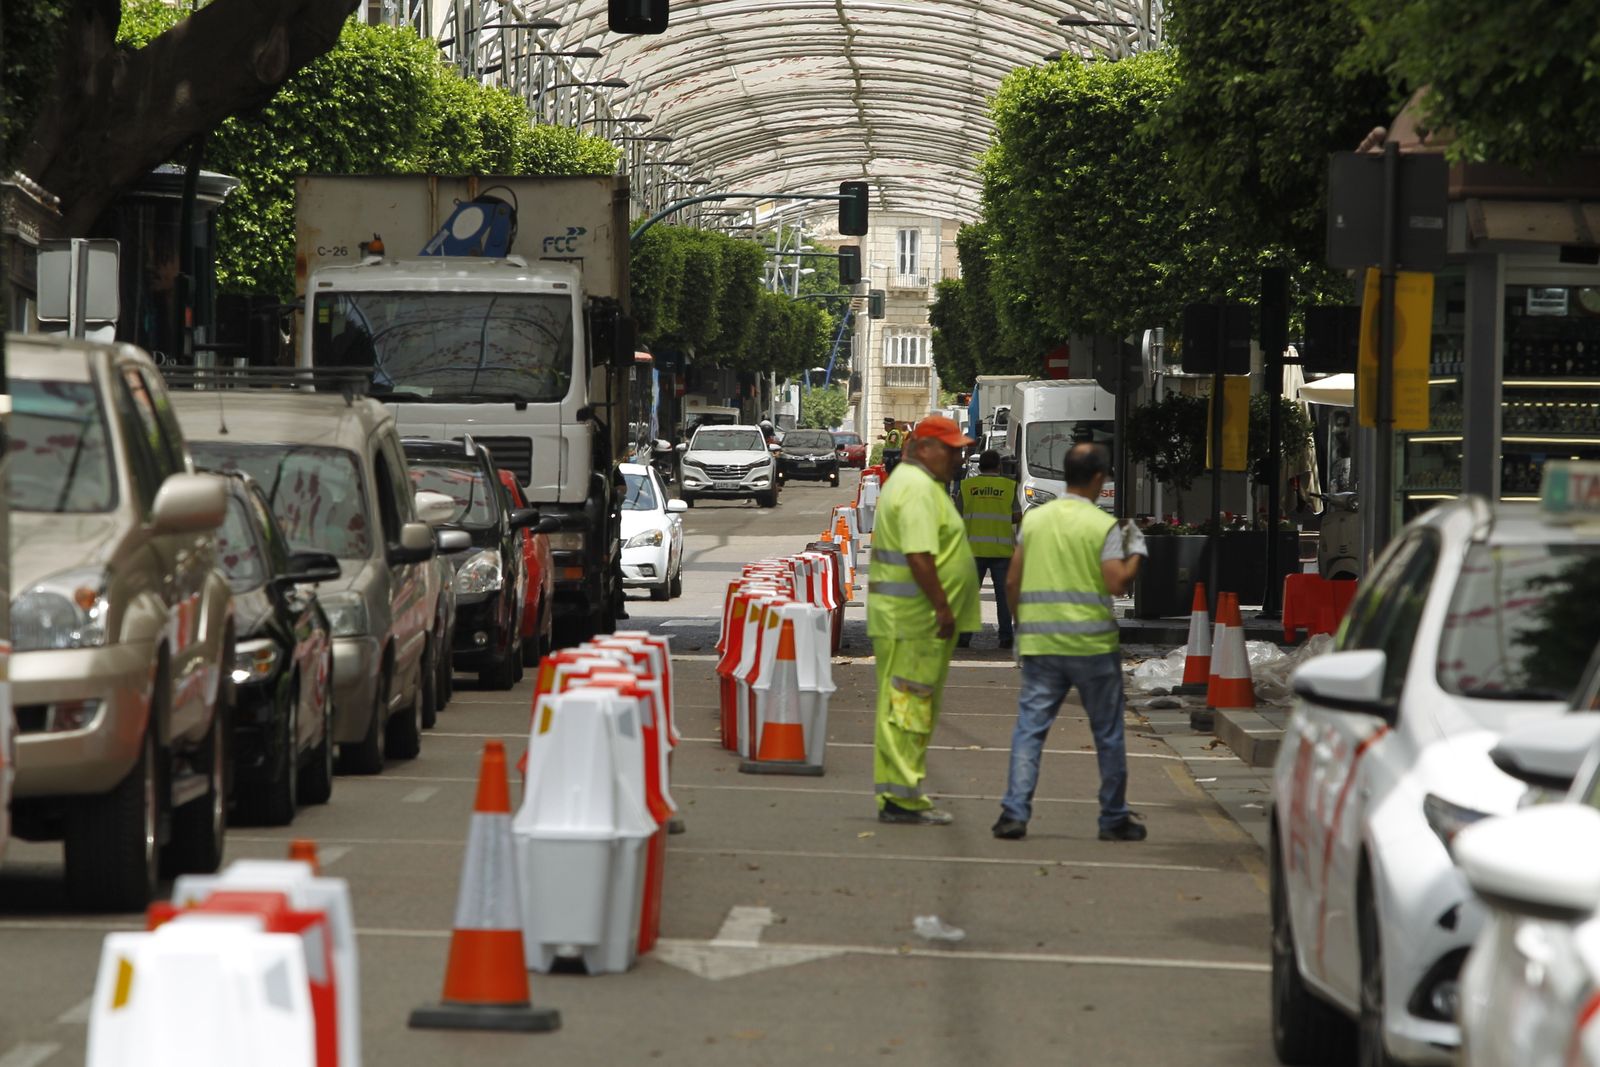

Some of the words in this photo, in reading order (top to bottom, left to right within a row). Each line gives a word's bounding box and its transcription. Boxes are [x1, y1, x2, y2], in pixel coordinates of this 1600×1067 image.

[317, 246, 348, 256] C-26
[151, 350, 177, 368] Dio
[980, 487, 1004, 496] villar
